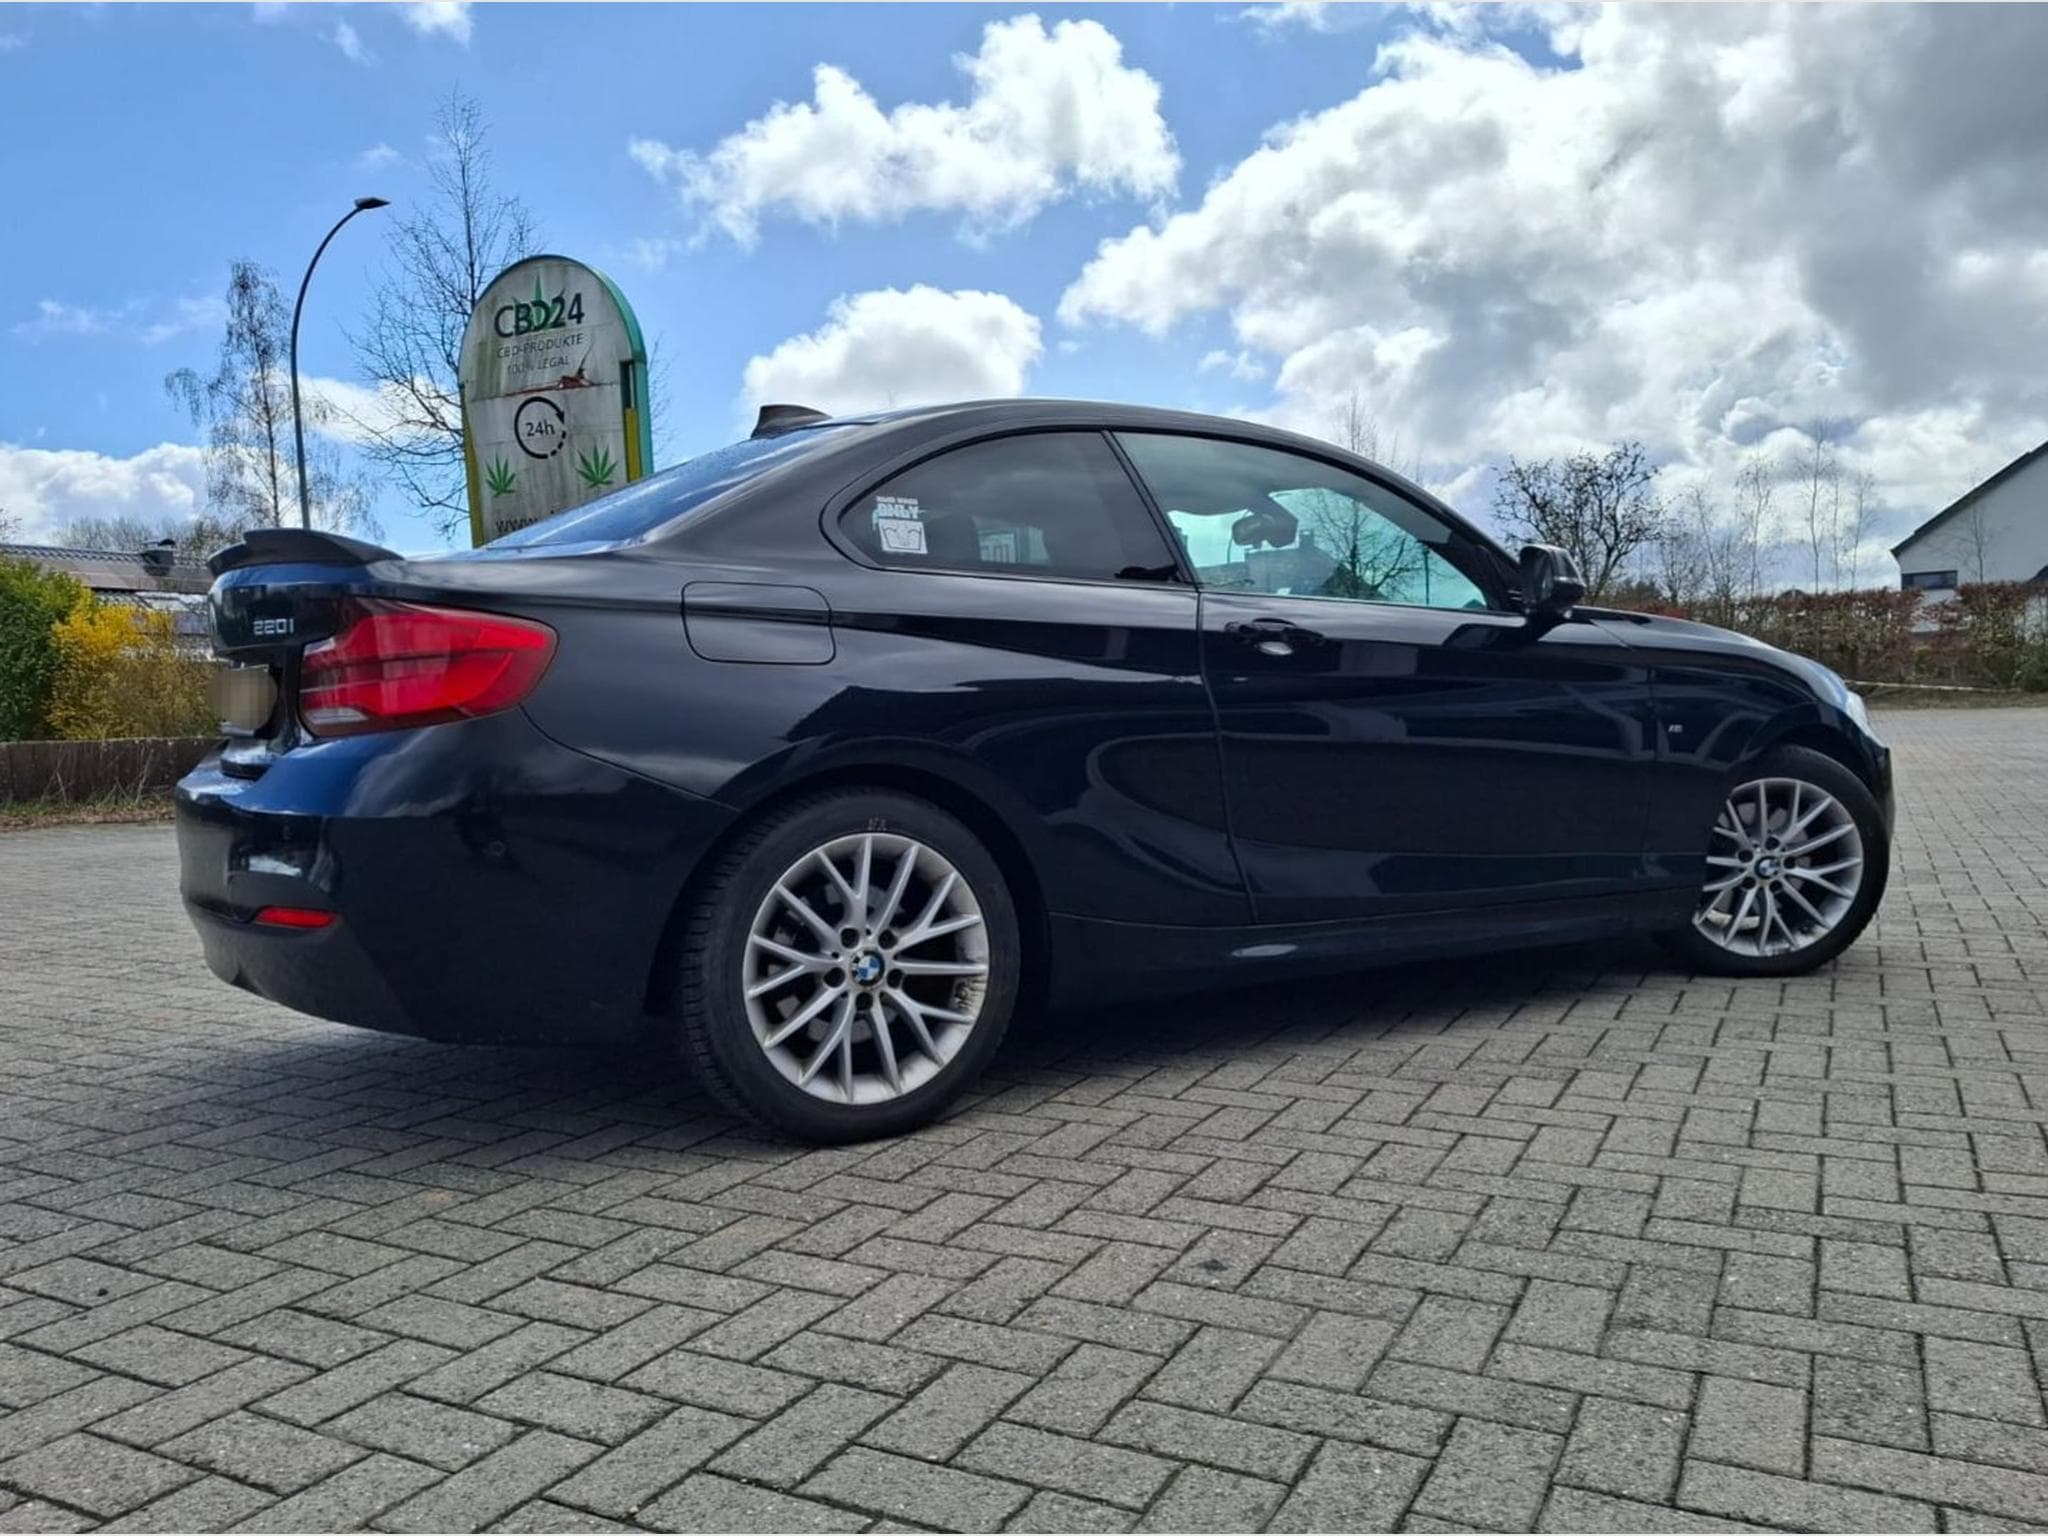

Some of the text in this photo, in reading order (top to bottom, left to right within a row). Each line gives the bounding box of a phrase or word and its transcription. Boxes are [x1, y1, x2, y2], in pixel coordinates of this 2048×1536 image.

[494, 293, 584, 338] CBD24
[496, 332, 585, 359] CBD-PRODUKTE
[525, 420, 555, 437] 24h
